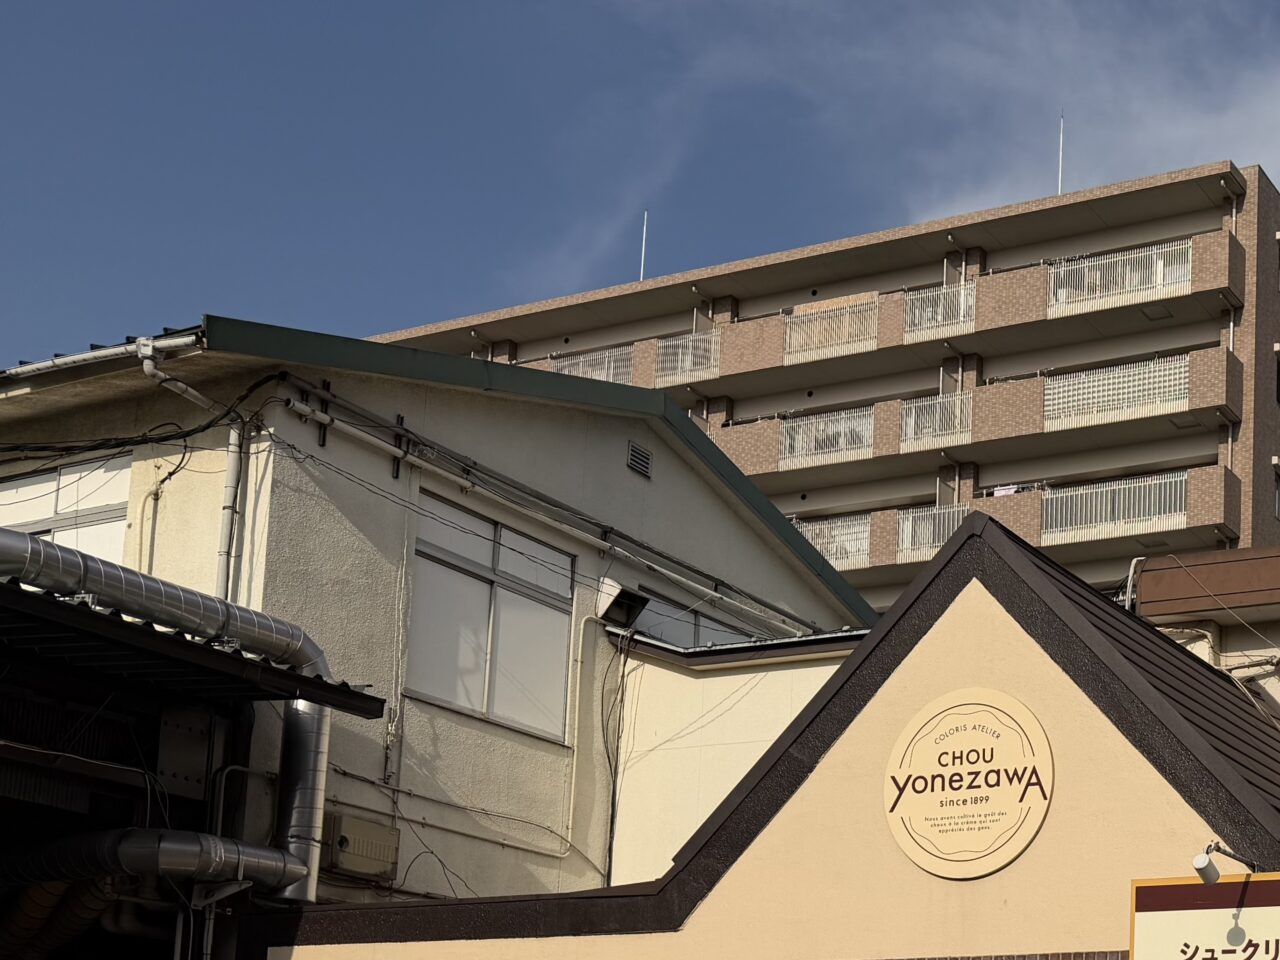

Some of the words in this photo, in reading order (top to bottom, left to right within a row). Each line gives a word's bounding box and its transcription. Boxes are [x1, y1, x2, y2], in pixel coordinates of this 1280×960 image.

[934, 724, 968, 746] COLORIS
[971, 723, 1001, 740] ATELIER
[937, 747, 994, 768] CHOU
[939, 798, 968, 808] since
[970, 795, 990, 806] 1899
